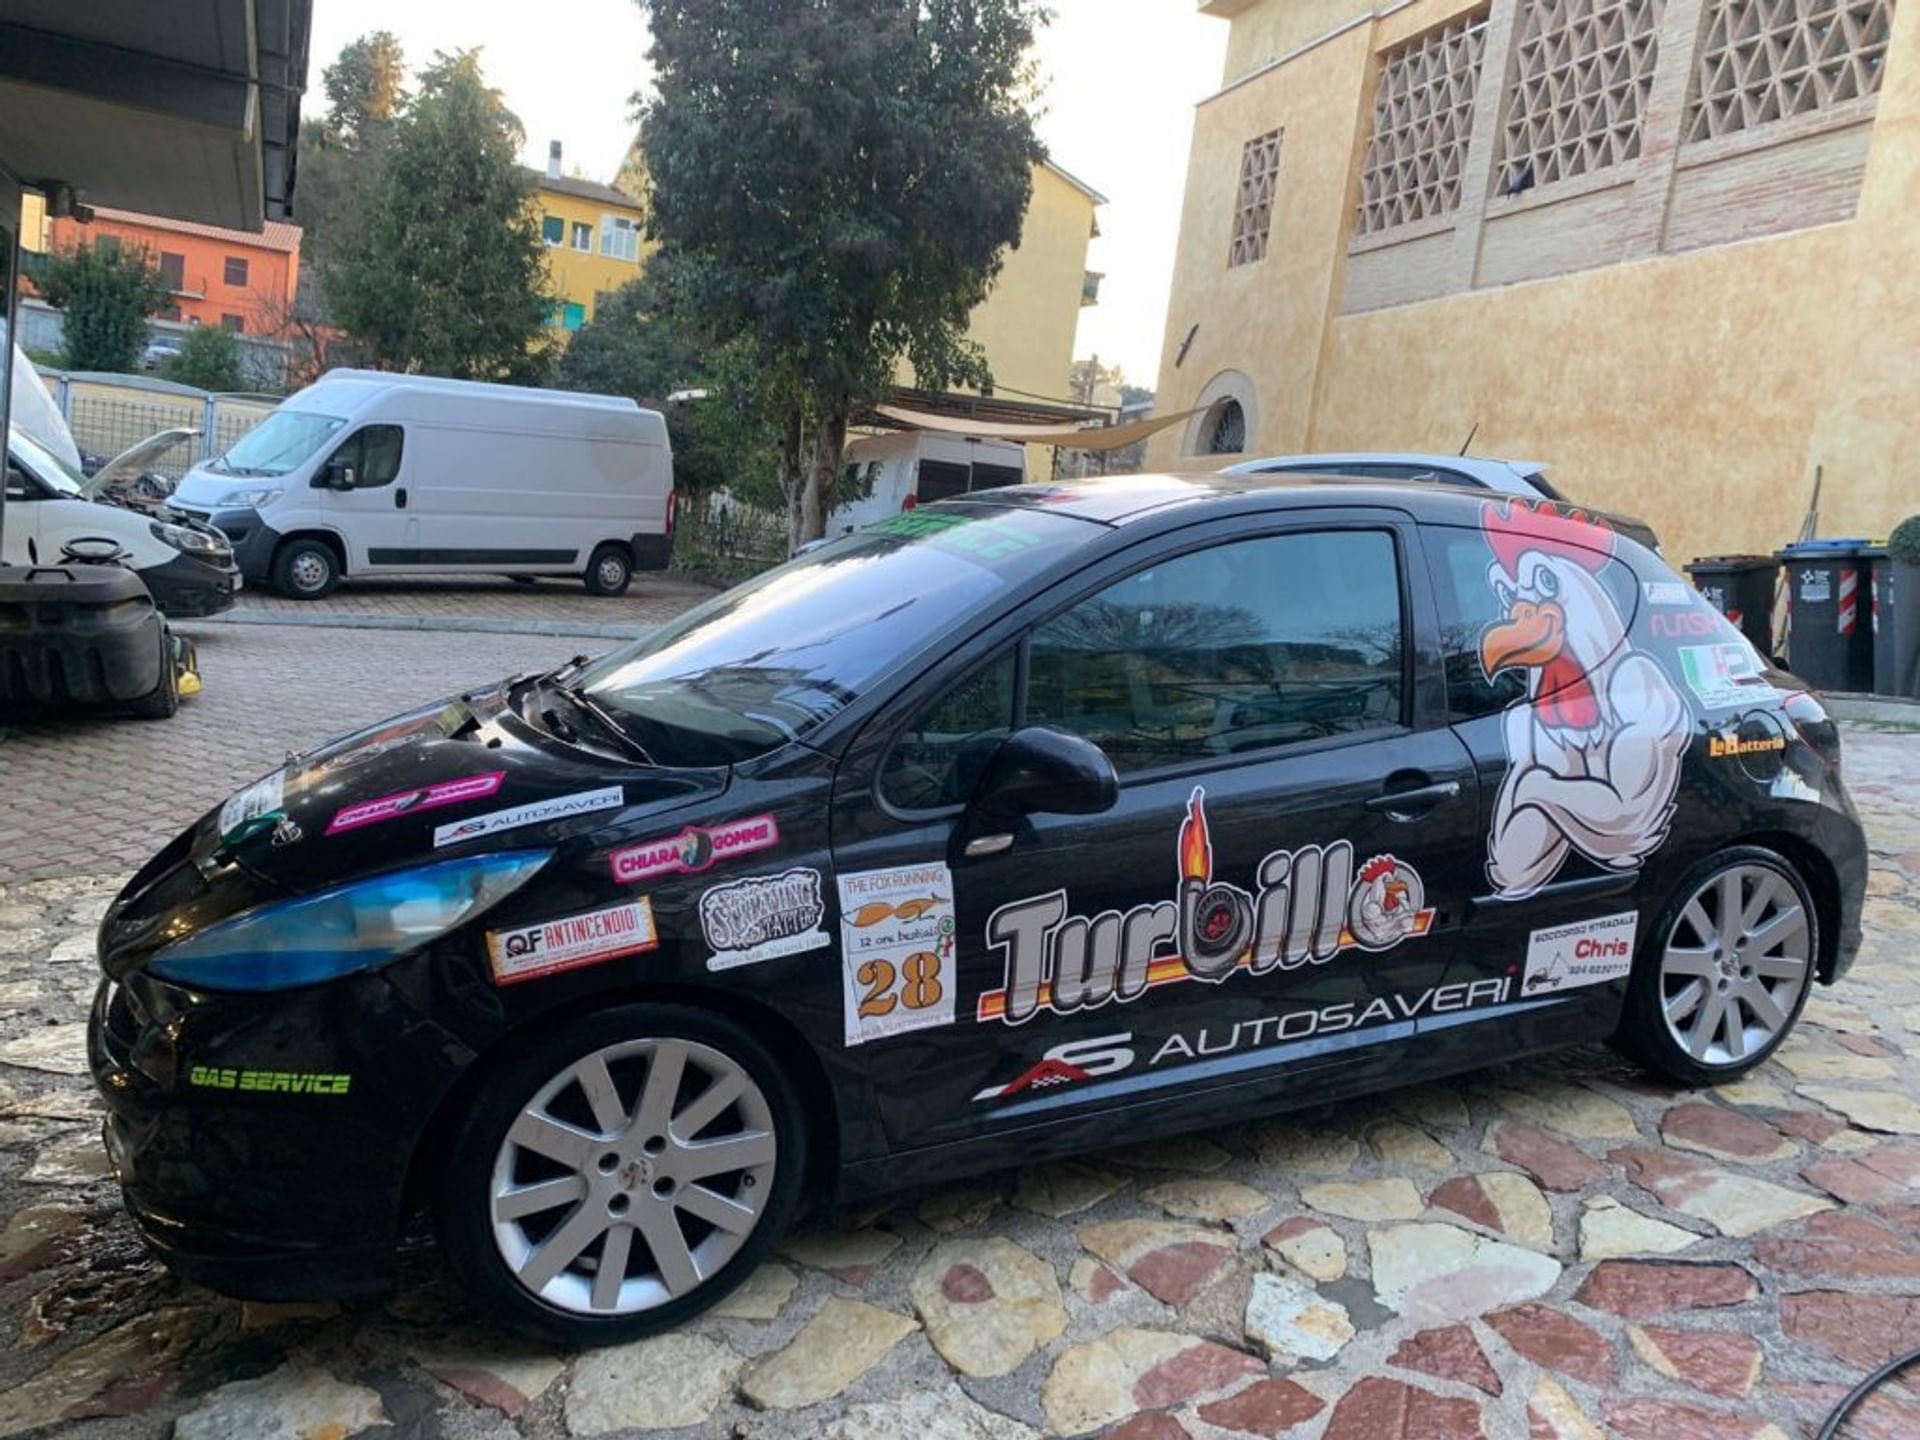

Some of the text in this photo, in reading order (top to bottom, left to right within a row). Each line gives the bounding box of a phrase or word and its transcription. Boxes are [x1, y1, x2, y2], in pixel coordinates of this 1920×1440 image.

[491, 793, 620, 828] AUTOSAVERI
[619, 823, 769, 874] CHIARA GOMME
[847, 880, 868, 894] THE
[869, 876, 891, 891] FOX
[892, 868, 945, 888] RUNNING
[543, 907, 637, 950] ANTINCENDIO
[1589, 916, 1634, 933] STRADALE
[860, 937, 872, 947] 12
[1574, 937, 1629, 960] Chris
[856, 951, 943, 1021] 28
[1148, 975, 1512, 1065] AUTOSAVERI
[190, 1066, 350, 1093] GAS SERVICE
